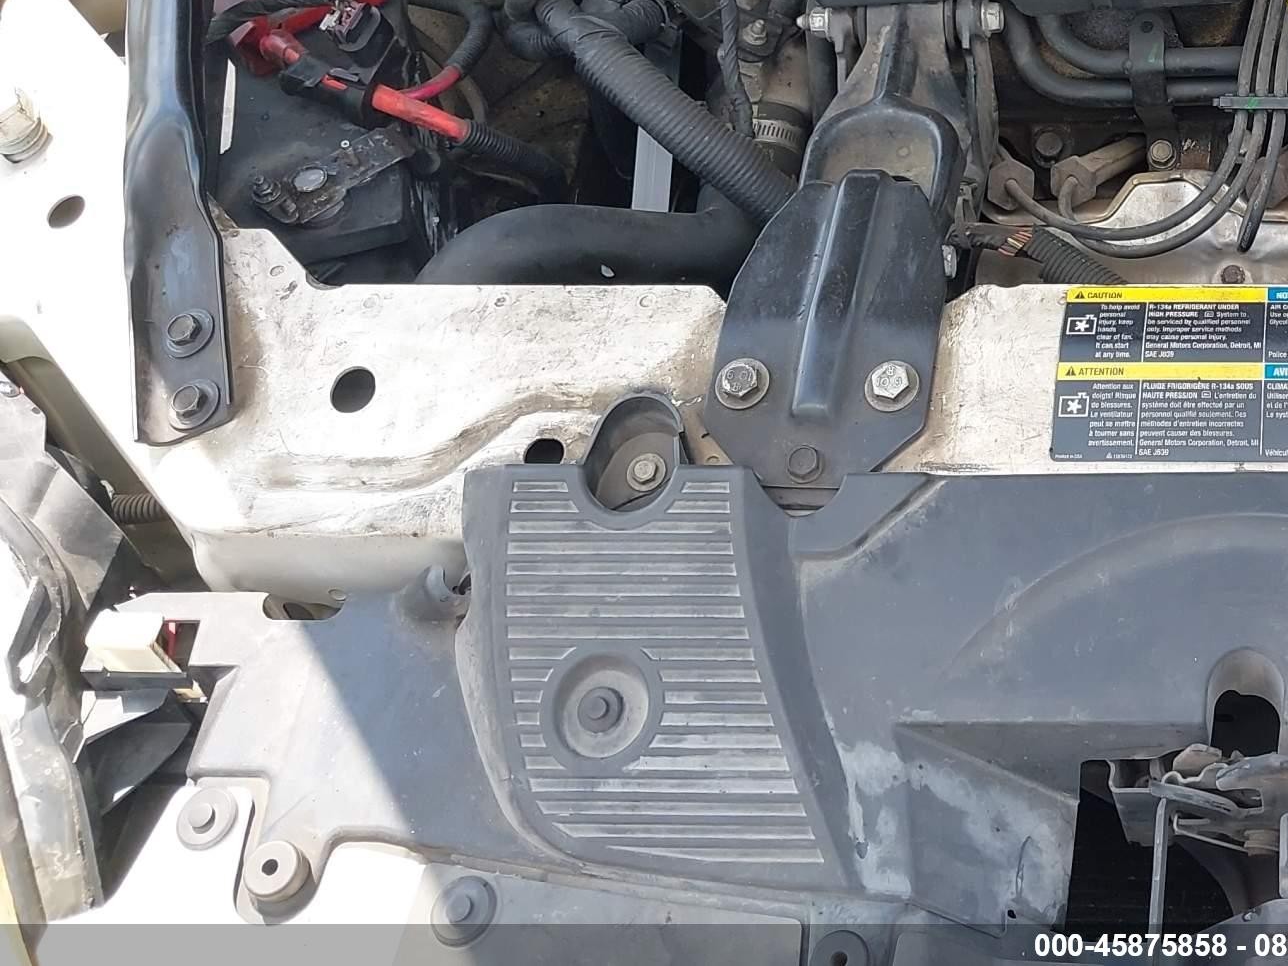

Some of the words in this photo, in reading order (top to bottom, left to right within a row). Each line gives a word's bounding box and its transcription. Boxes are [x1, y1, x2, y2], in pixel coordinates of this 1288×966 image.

[1088, 291, 1122, 300] CAUTION
[1192, 342, 1228, 350] Corporation,
[1079, 367, 1124, 376] ATTENTION
[1188, 438, 1225, 447] Corporation,
